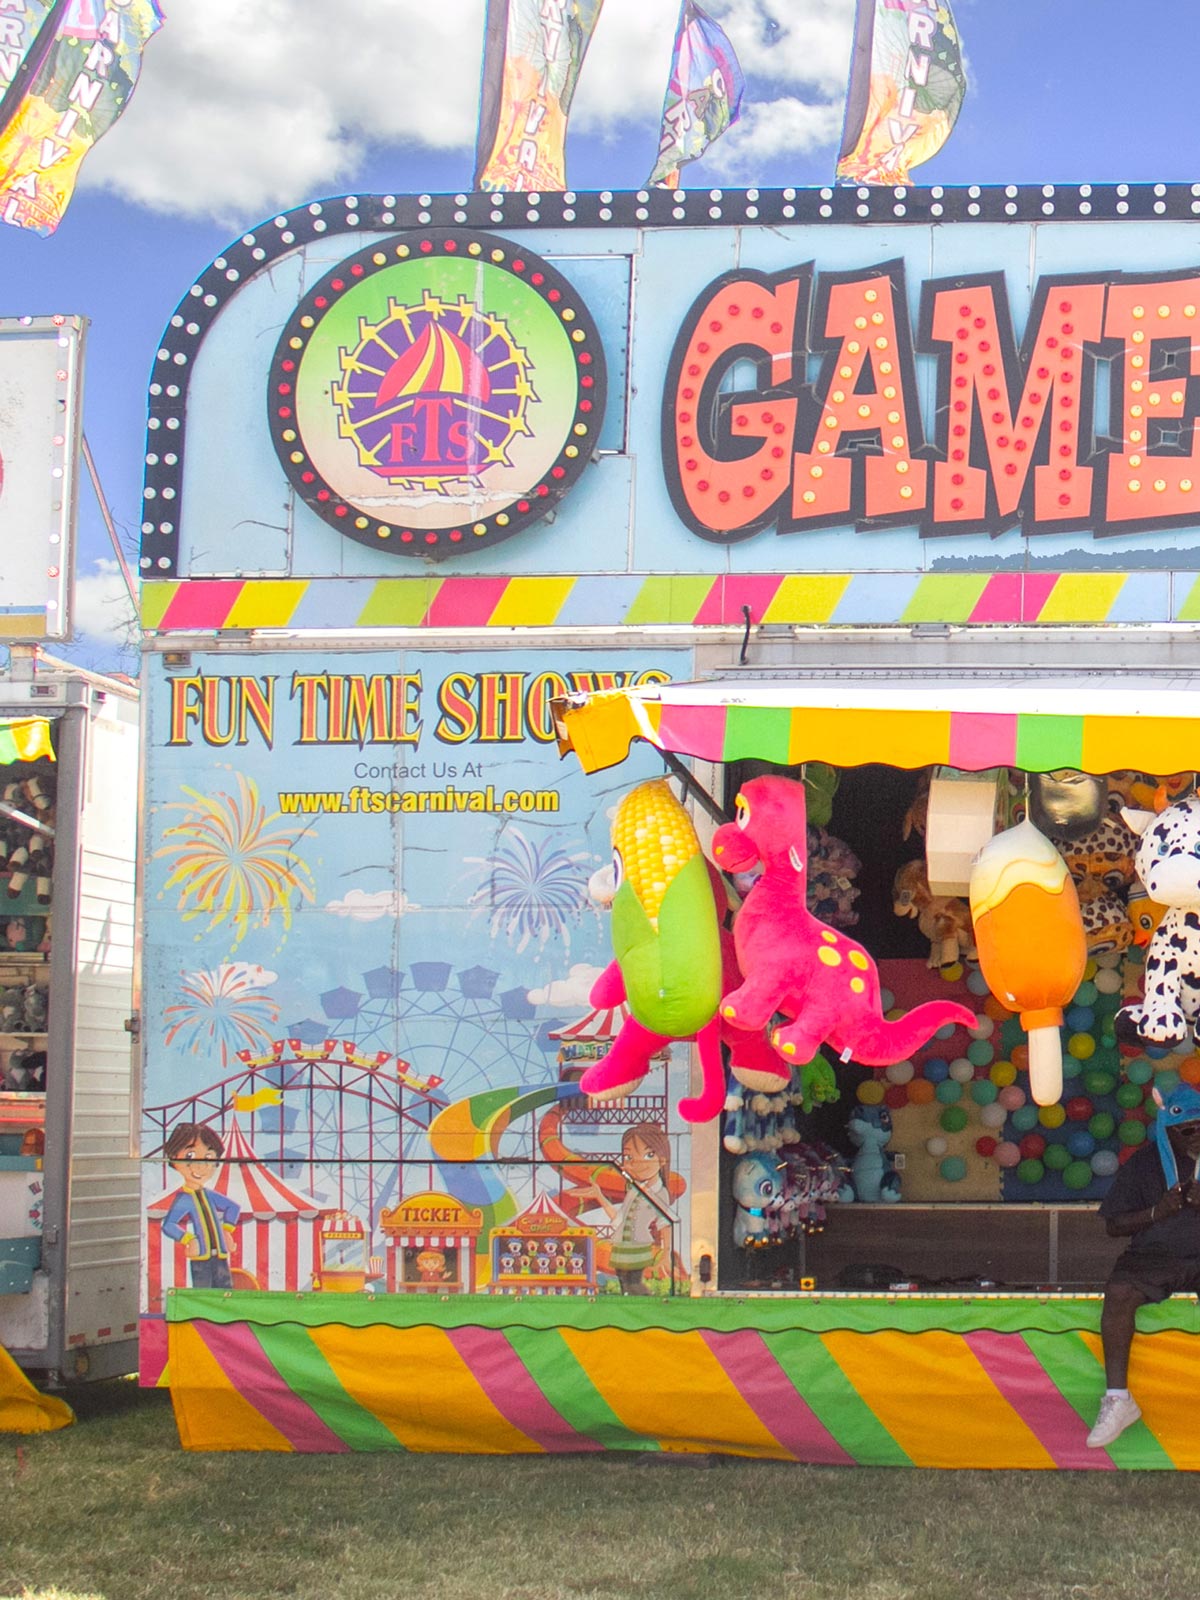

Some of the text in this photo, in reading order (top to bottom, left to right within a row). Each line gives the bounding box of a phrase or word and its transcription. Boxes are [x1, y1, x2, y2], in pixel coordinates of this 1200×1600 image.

[3, 0, 132, 228] ARNIVAL
[389, 397, 476, 462] FTS
[165, 667, 673, 752] FUN TIME SHO
[354, 761, 484, 780] Contact Us At
[279, 786, 559, 814] www.ftscarnival.com
[402, 1207, 462, 1223] TICKET
